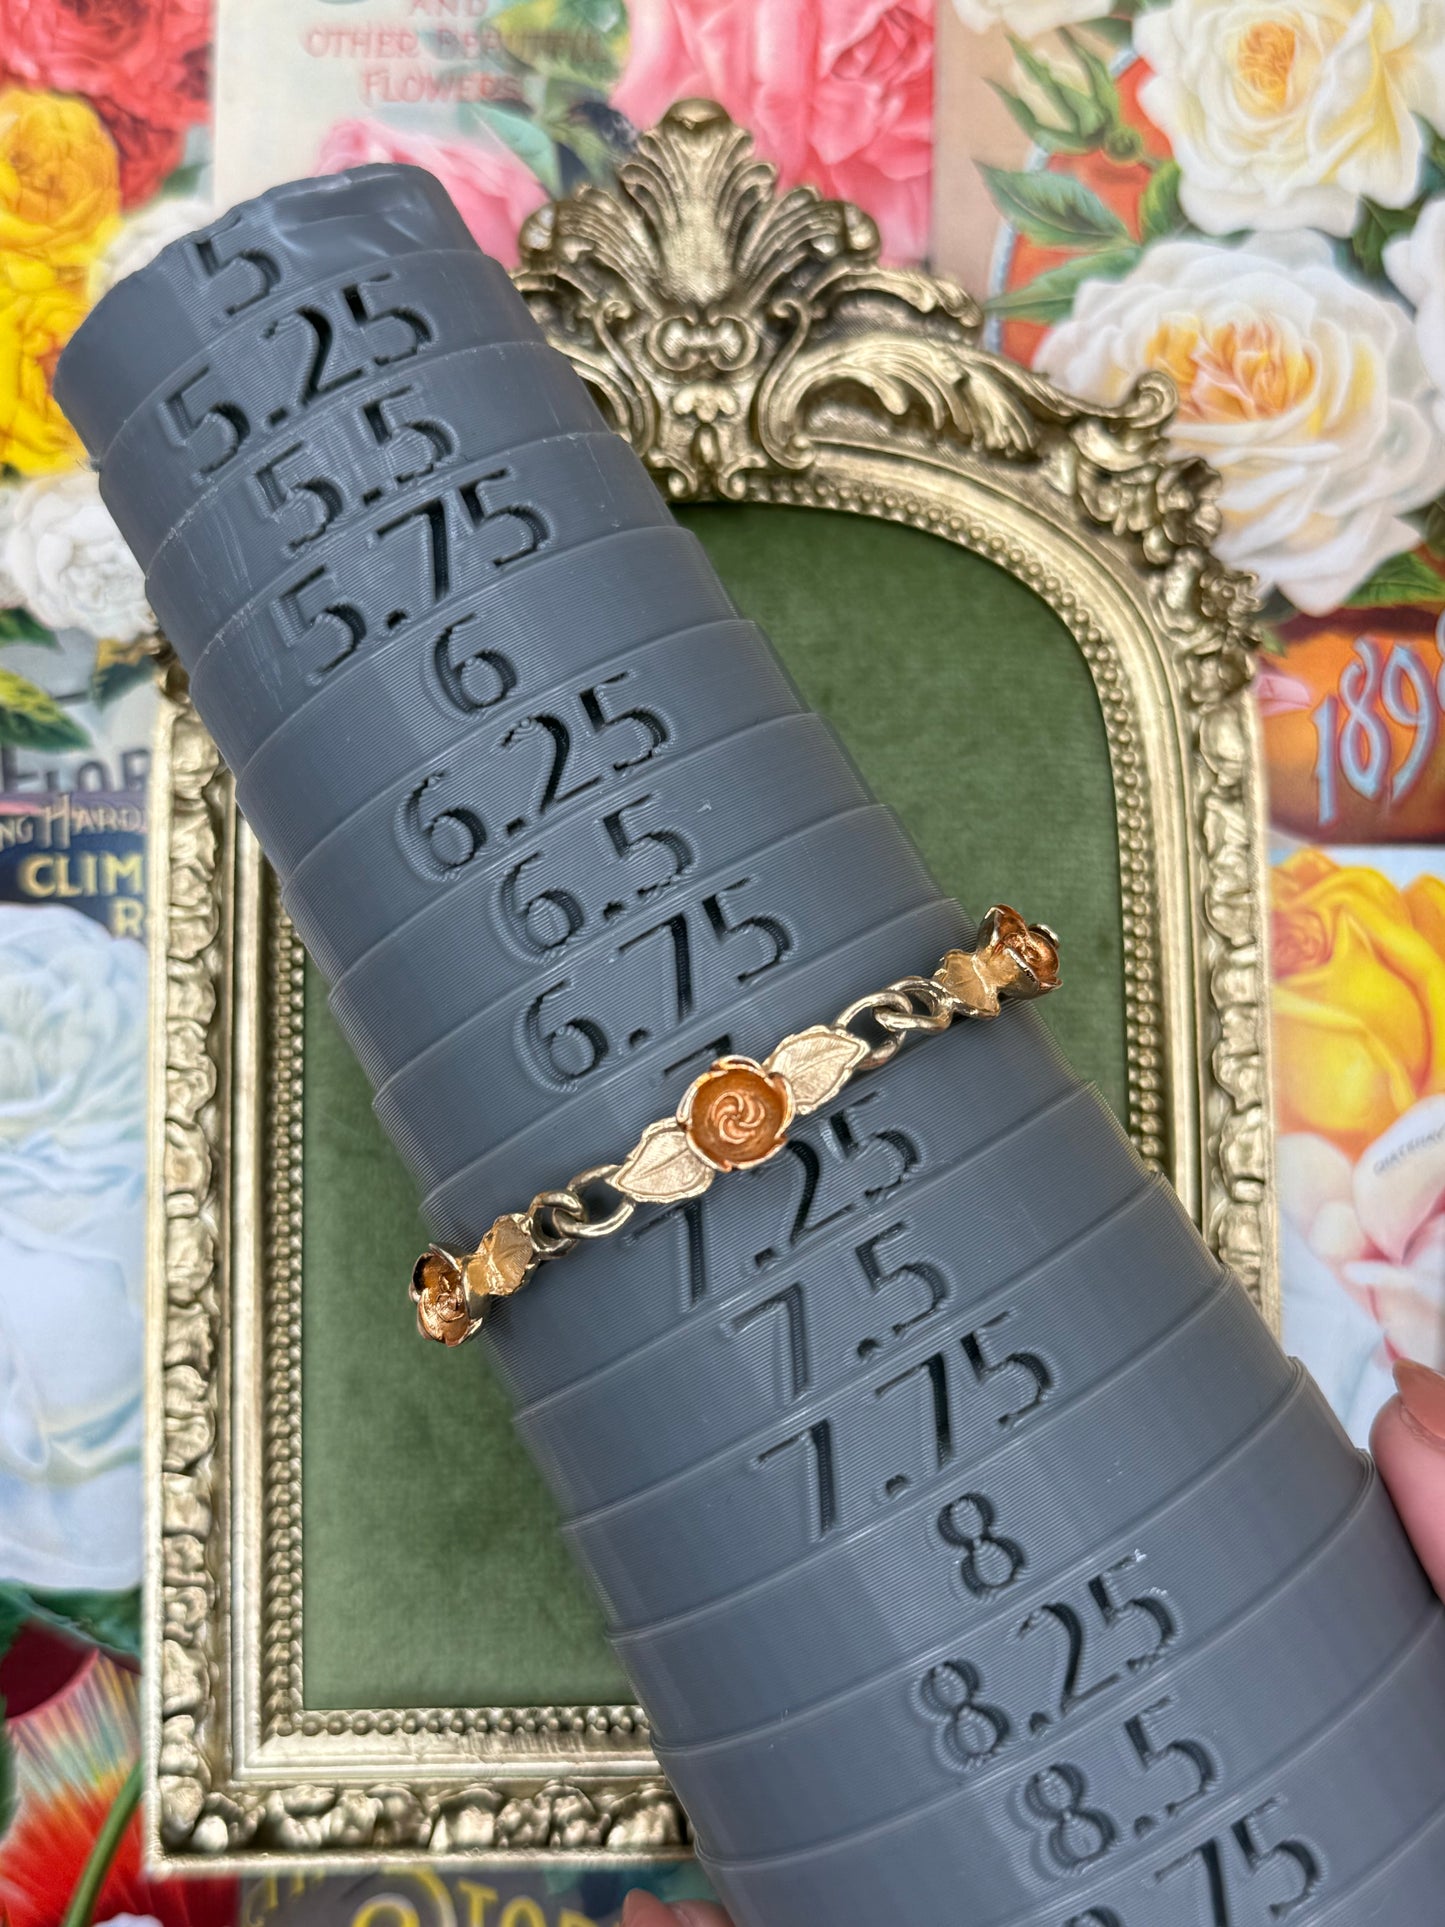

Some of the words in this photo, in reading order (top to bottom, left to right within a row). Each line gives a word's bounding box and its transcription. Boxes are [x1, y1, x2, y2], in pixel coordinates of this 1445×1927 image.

[306, 28, 419, 58] OTHER
[363, 72, 526, 103] FLOWERS
[184, 212, 283, 318] 5
[163, 273, 437, 482] 5.25
[254, 385, 458, 553] 5.5
[273, 467, 553, 681] 5.75
[425, 613, 517, 720] 6
[396, 671, 675, 881] 6.25
[21, 853, 144, 898] CLIM
[492, 794, 697, 965] 6.5
[515, 877, 797, 1091] 6.75
[627, 1091, 923, 1310] 7.25
[723, 1222, 953, 1401] 7.5
[753, 1308, 1060, 1541] 7.75
[932, 1492, 1026, 1598] 8
[912, 1550, 1181, 1768] 8.25
[1018, 1695, 1220, 1875] 8.5
[1062, 1795, 1322, 1927] 75
